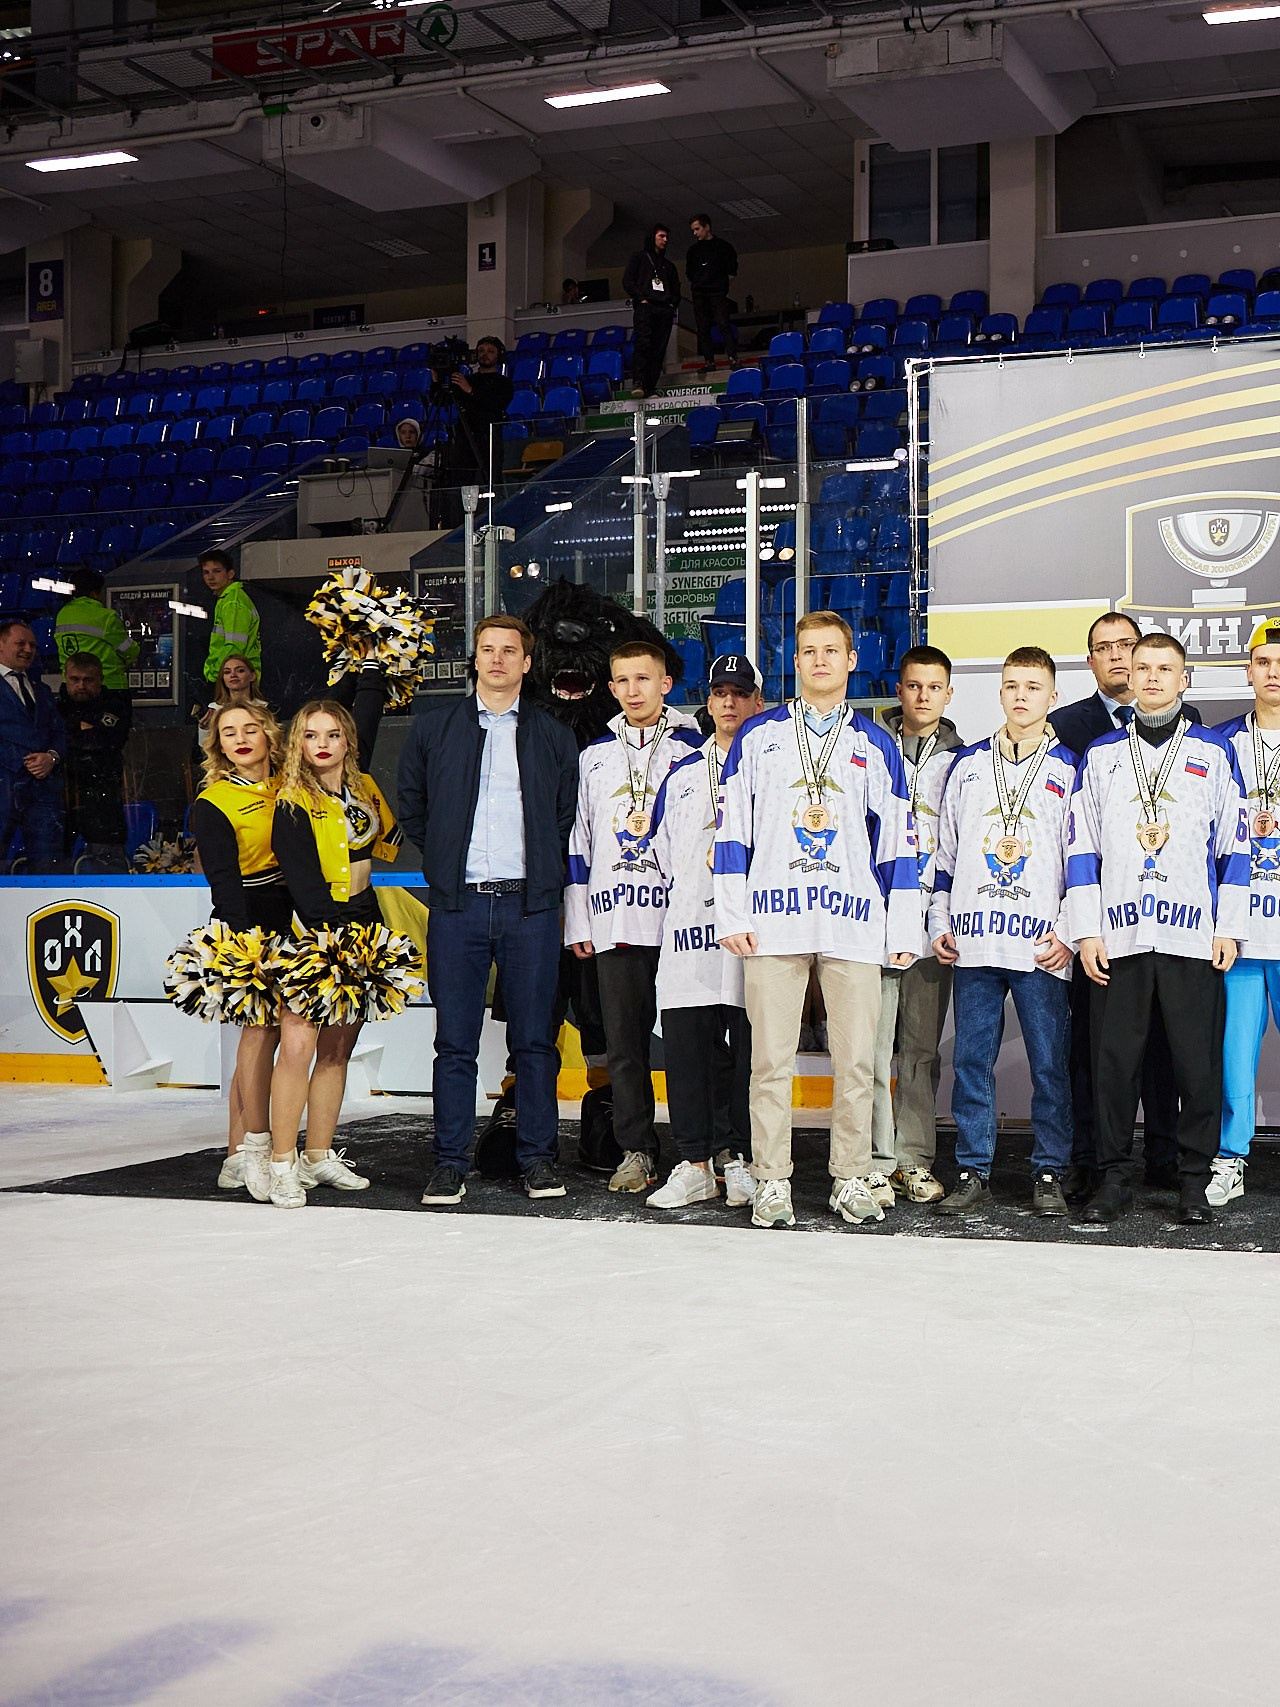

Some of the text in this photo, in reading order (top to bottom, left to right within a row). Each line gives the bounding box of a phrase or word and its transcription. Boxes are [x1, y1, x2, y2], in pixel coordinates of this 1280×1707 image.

[256, 21, 401, 66] SPAR
[482, 247, 492, 263] 1
[39, 268, 53, 297] 8
[328, 557, 361, 567] ВЫХОД
[680, 558, 701, 571] ДЛЯ
[752, 887, 802, 916] МВД
[673, 923, 721, 953] МВД
[950, 911, 985, 938] МВД
